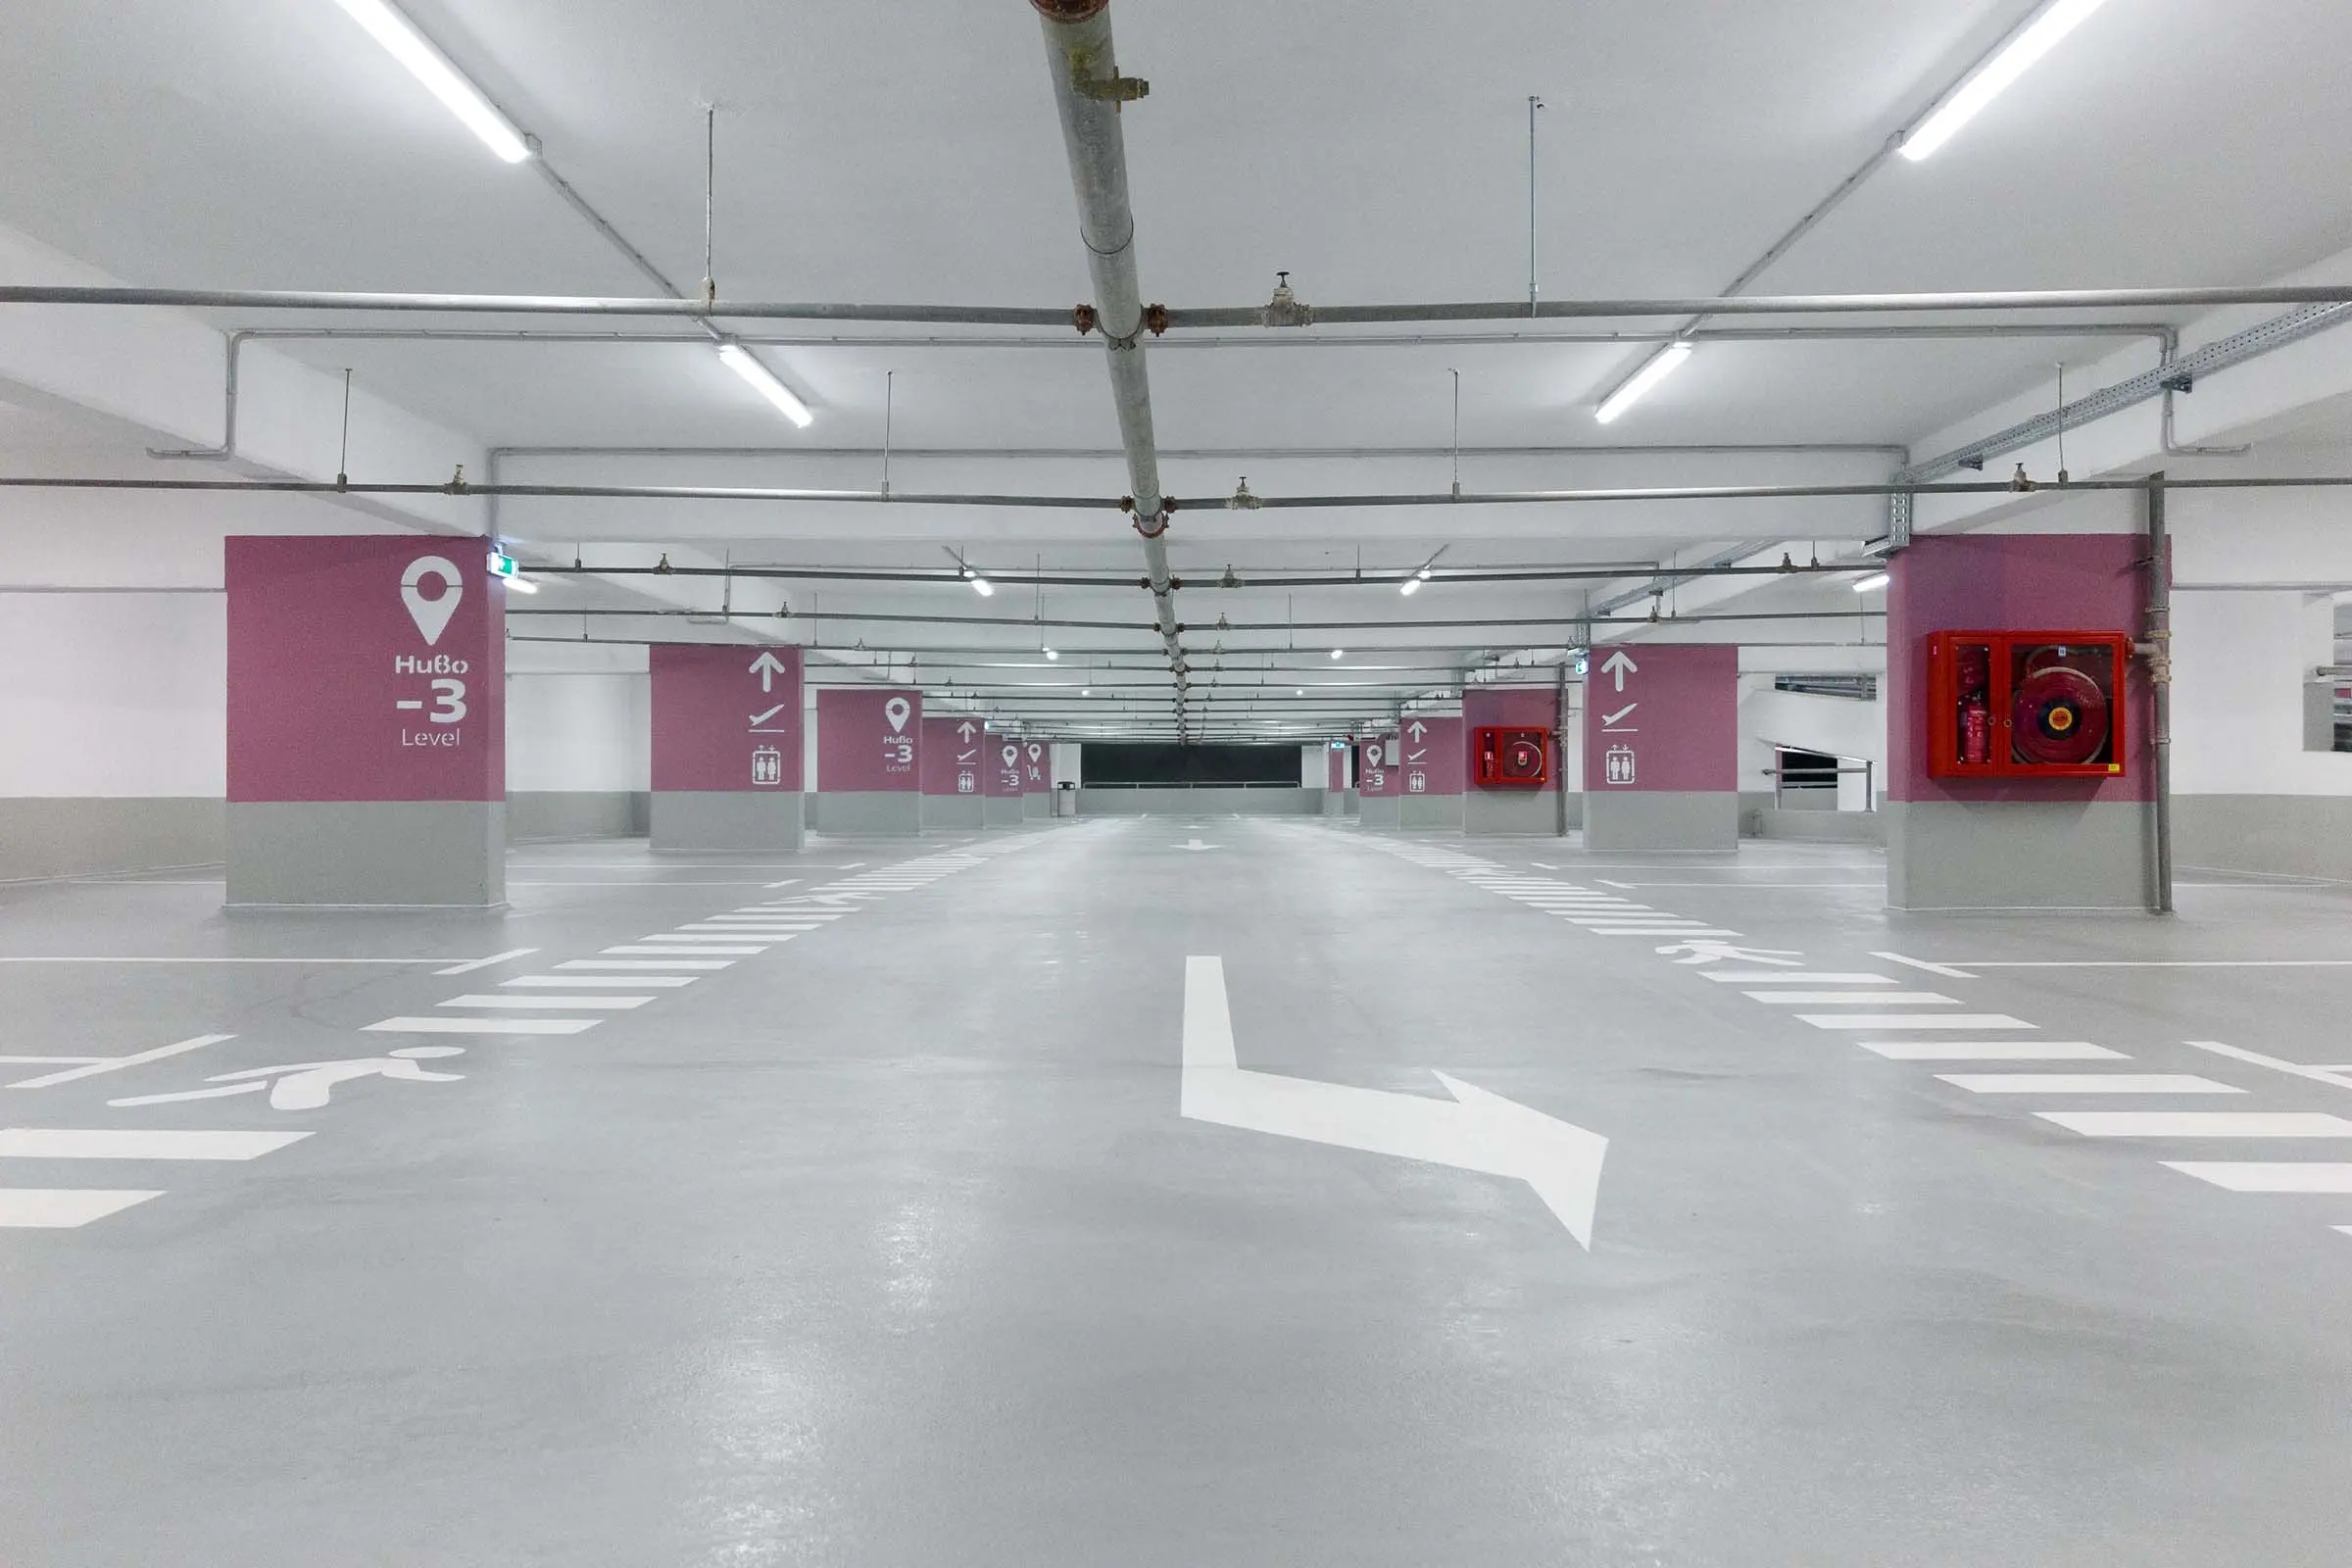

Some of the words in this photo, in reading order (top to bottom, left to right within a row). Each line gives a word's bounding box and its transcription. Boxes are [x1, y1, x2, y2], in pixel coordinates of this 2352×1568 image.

[396, 678, 466, 723] -3
[402, 727, 460, 746] Level
[884, 745, 912, 762] -3
[1002, 774, 1019, 786] -3
[1366, 774, 1384, 785] -3
